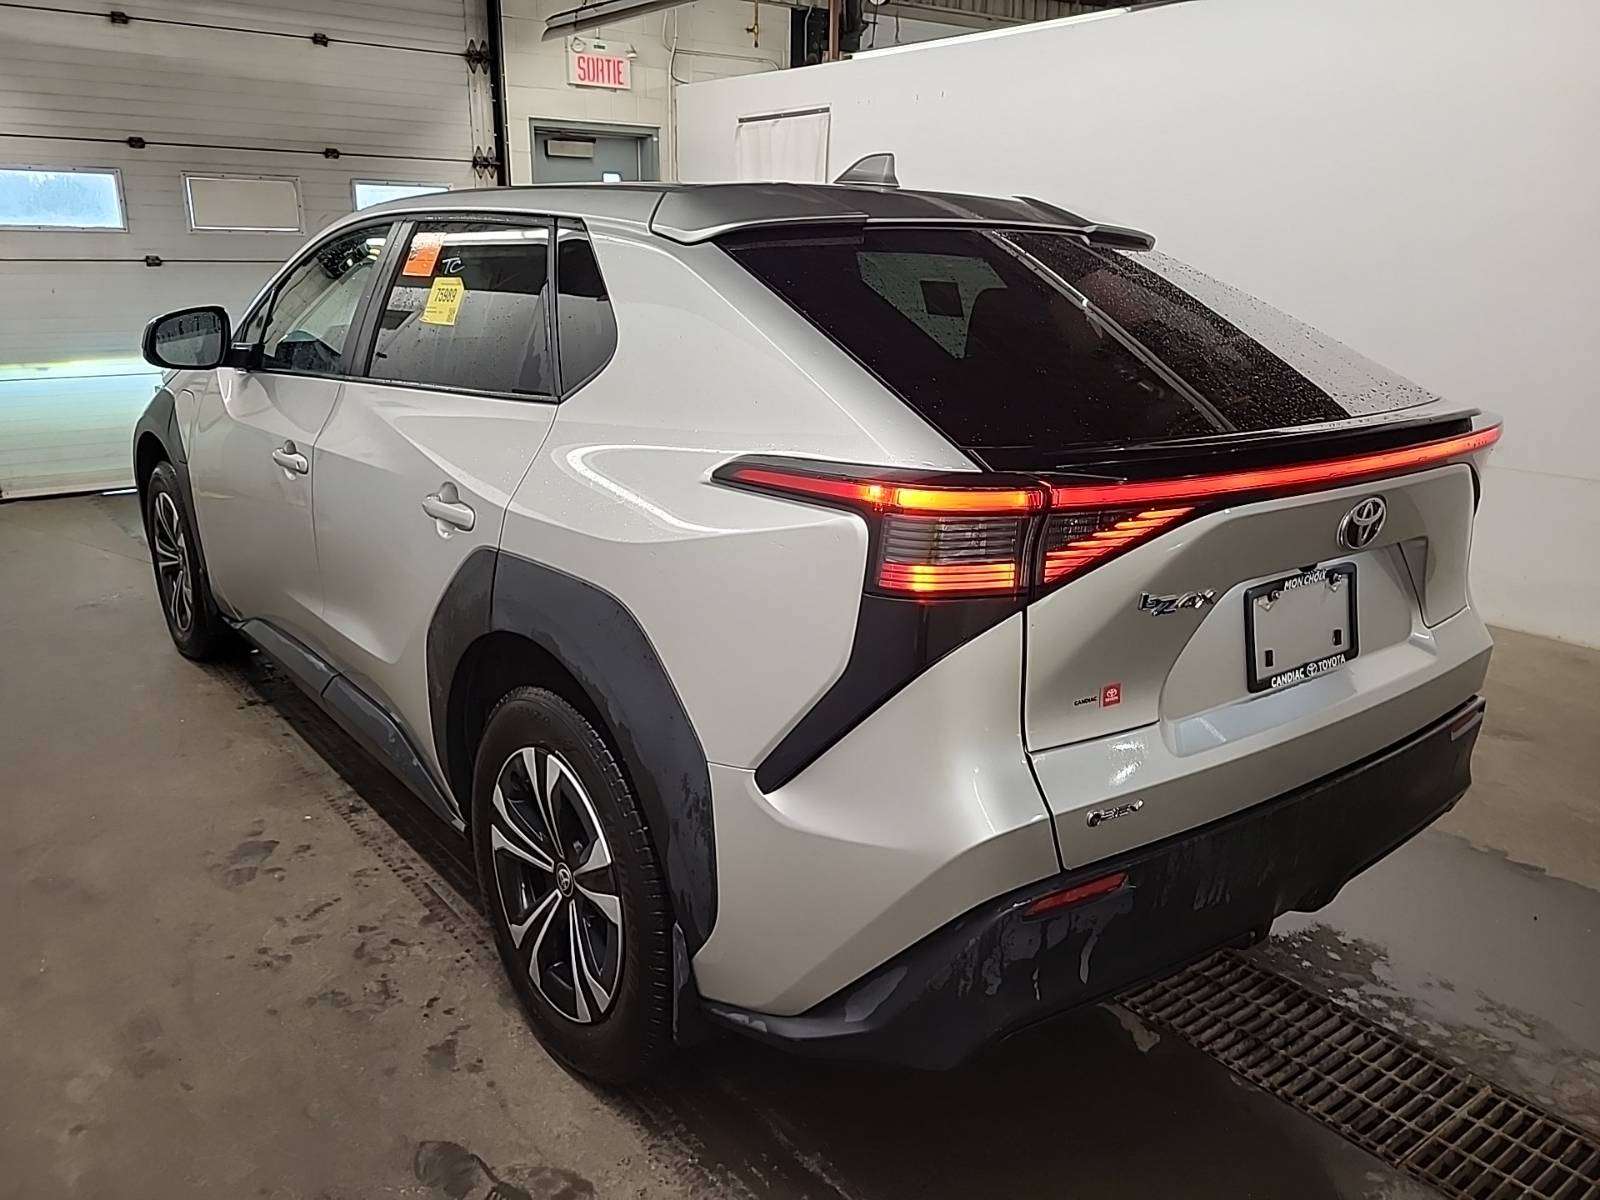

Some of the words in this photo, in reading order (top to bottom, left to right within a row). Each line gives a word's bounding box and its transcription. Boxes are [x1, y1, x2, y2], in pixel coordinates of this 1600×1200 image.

[577, 56, 624, 85] SORTIE
[442, 258, 465, 274] TC
[1284, 576, 1304, 591] MON
[1302, 568, 1327, 584] CHOIX
[1271, 668, 1305, 687] CANDIAC
[1318, 654, 1346, 672] TOYOTA
